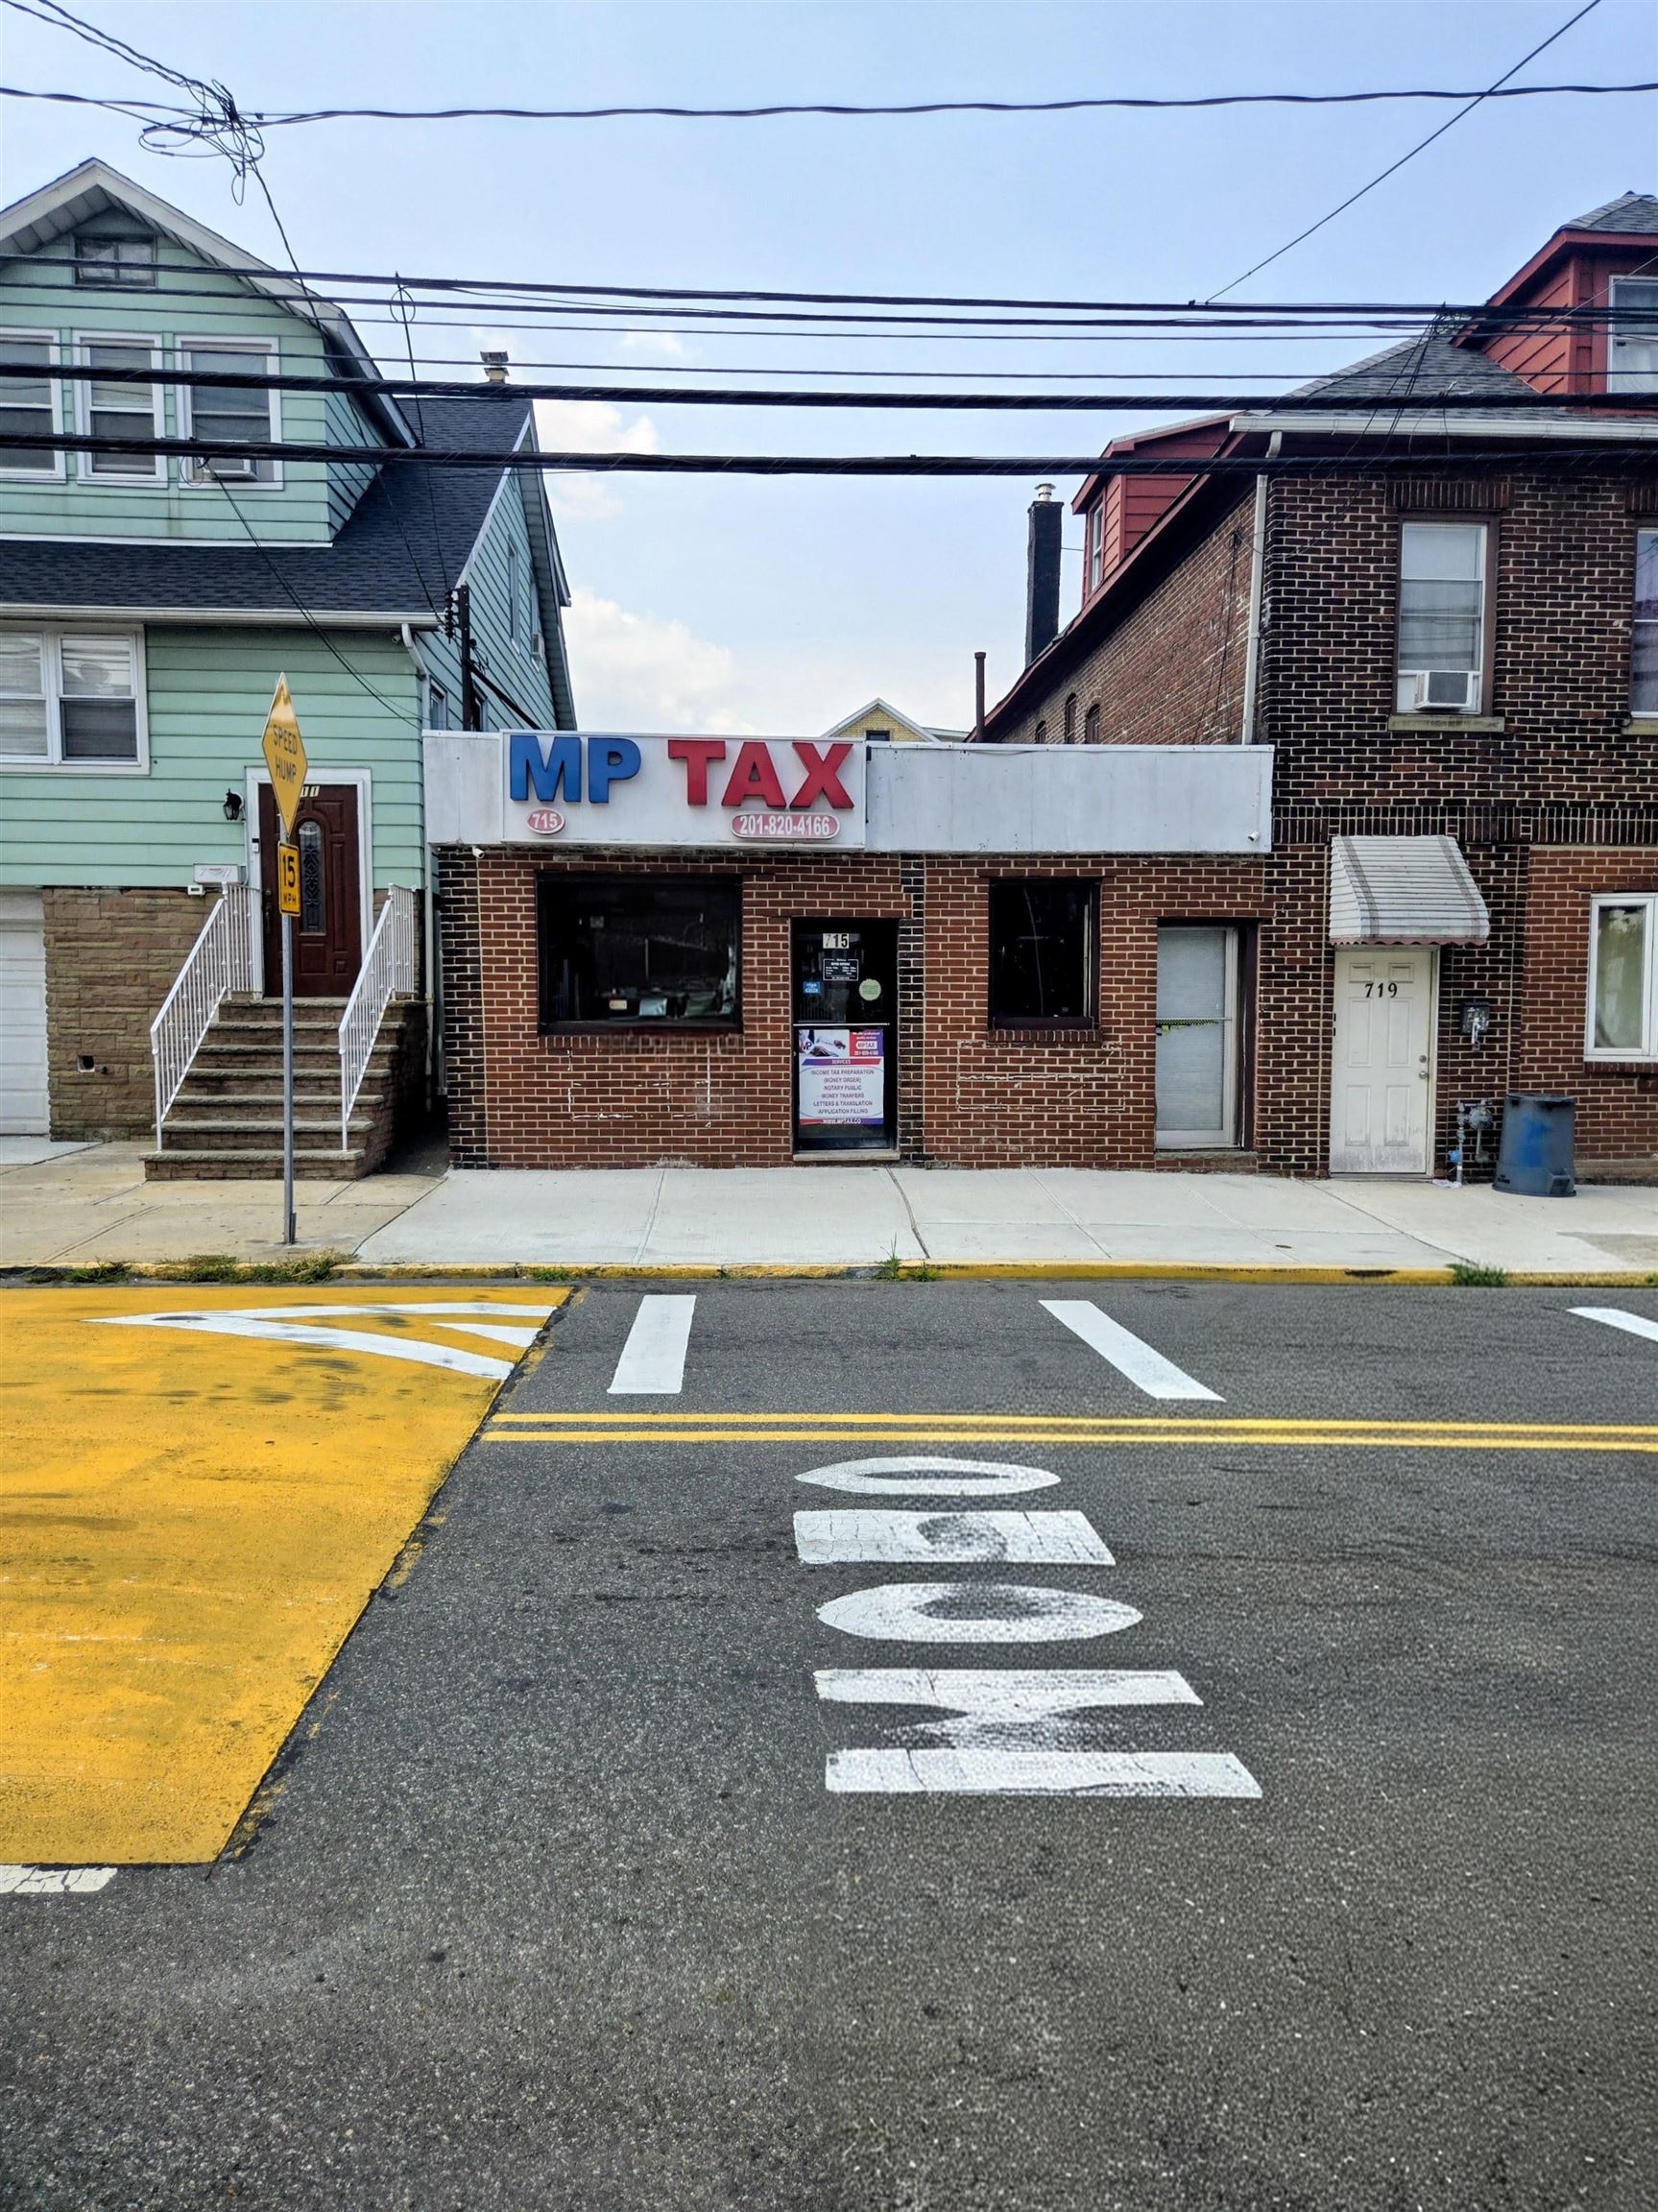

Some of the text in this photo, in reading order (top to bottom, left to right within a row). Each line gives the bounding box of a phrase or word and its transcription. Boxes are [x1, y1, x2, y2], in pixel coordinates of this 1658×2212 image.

[273, 724, 298, 756] SPEED
[276, 755, 297, 784] HUMP
[510, 734, 854, 809] MP TAX
[532, 814, 559, 830] 715
[739, 816, 830, 836] 201-820-4166
[282, 854, 296, 888] 15
[283, 892, 297, 904] MPH
[825, 933, 848, 948] 715
[1364, 982, 1398, 998] 719
